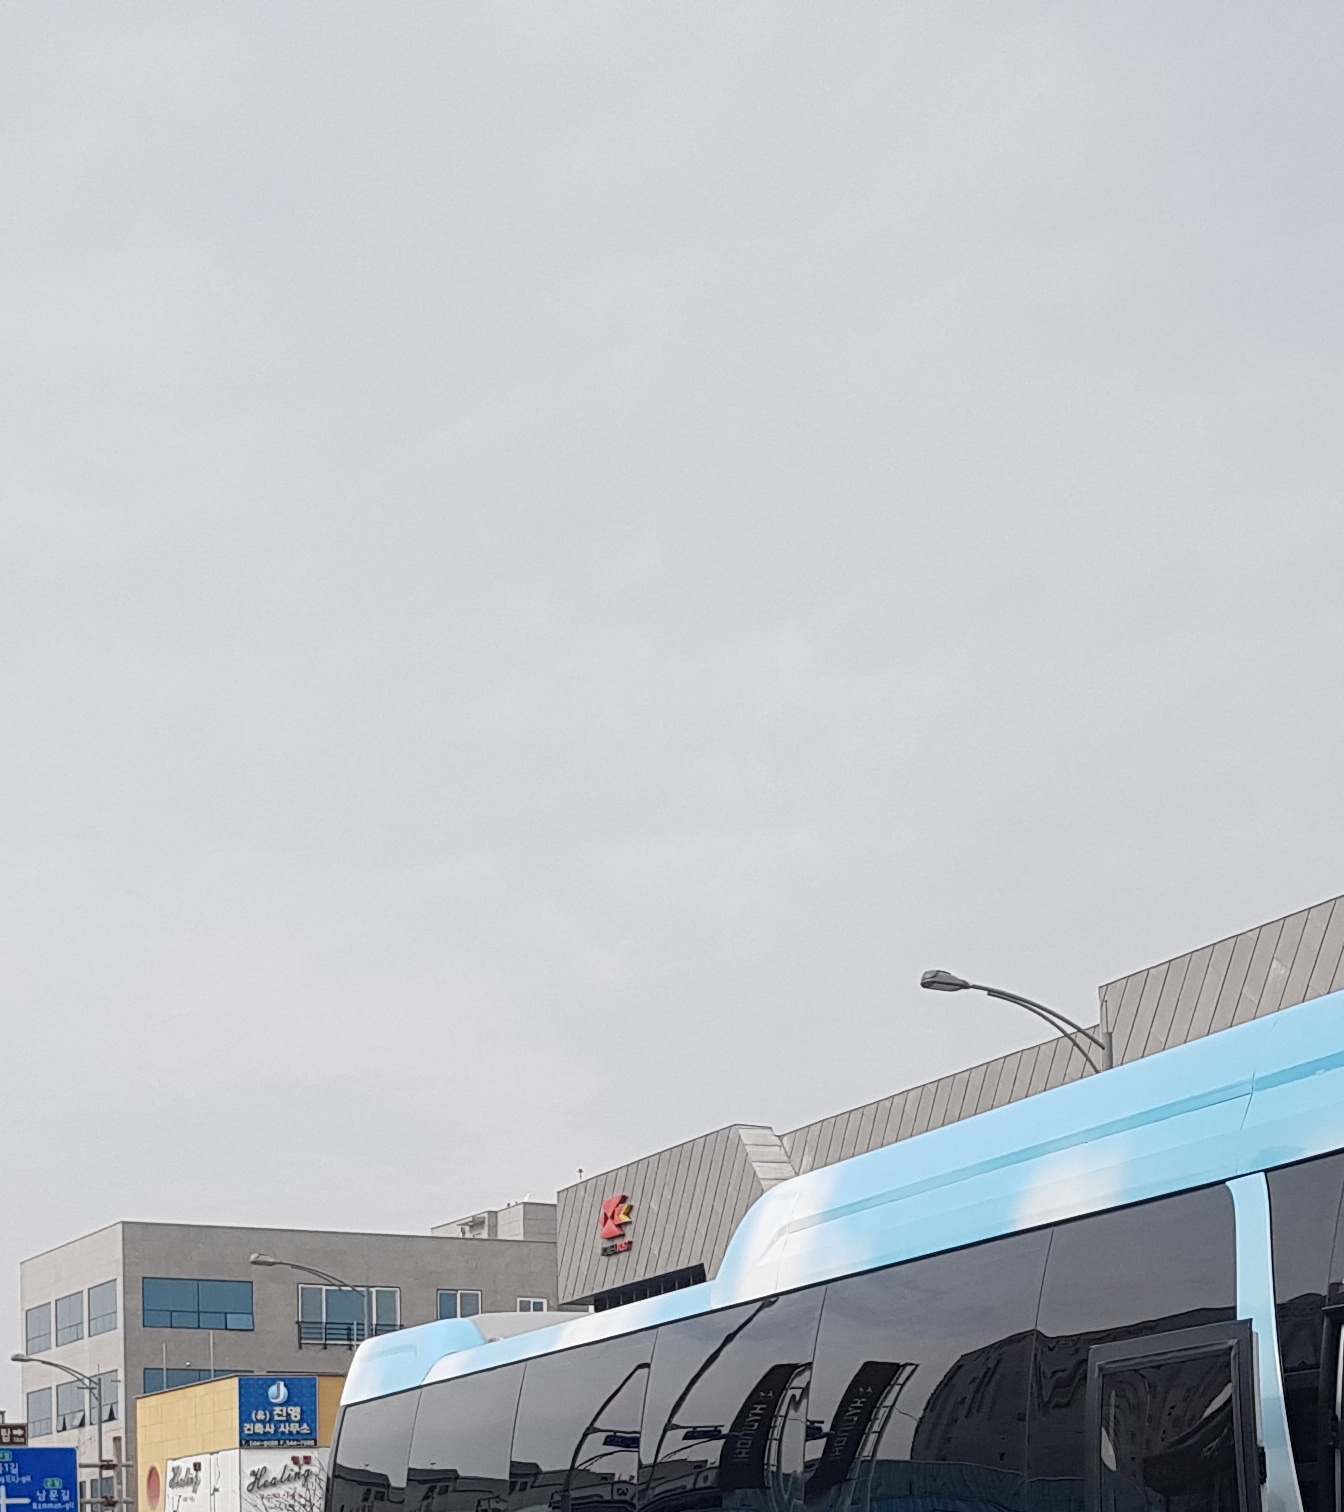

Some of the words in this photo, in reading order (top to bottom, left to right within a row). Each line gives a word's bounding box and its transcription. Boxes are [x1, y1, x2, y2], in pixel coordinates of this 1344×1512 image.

[273, 1406, 301, 1421] 진영
[243, 1423, 275, 1435] 건축사
[278, 1422, 311, 1434] 사무소
[246, 1464, 312, 1493] Healing
